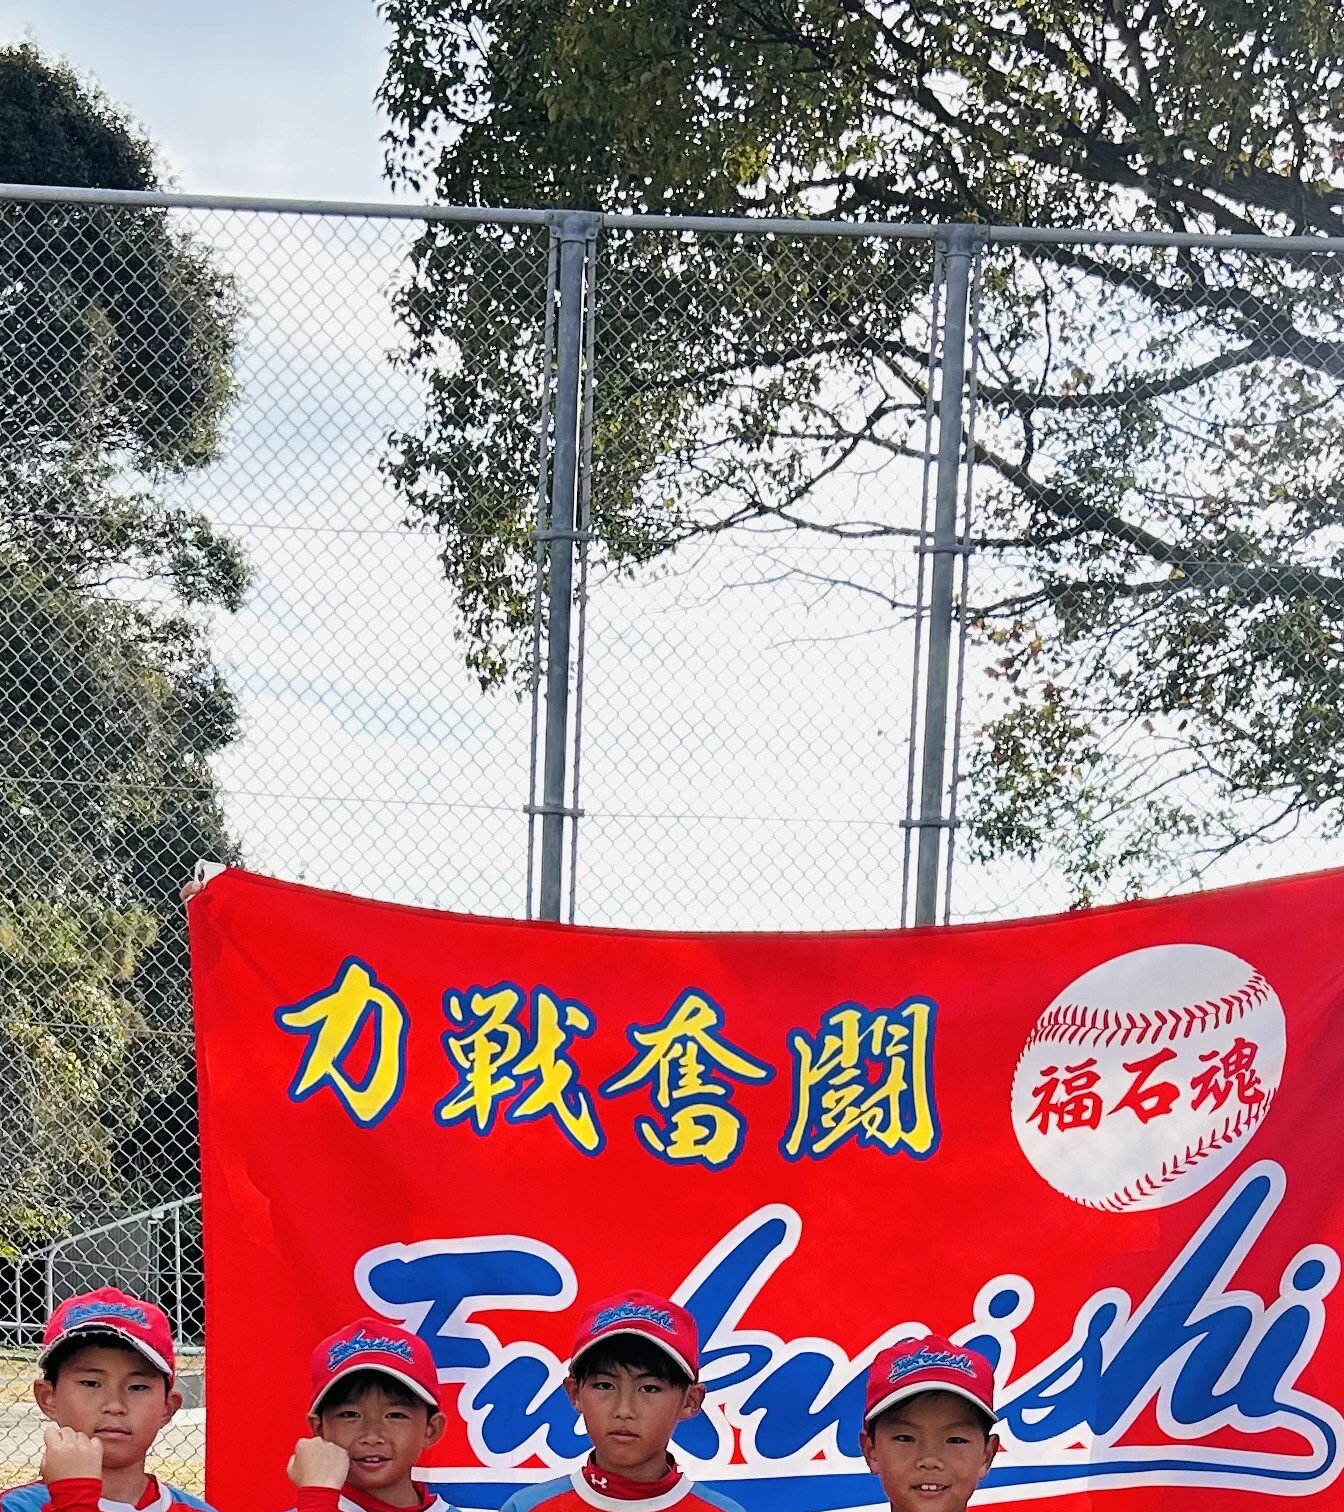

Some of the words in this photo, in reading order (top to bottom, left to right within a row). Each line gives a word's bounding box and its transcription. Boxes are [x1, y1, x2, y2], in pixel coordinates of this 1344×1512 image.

[275, 956, 939, 1168] 力戦奮闘
[1027, 1037, 1263, 1136] 福石魂
